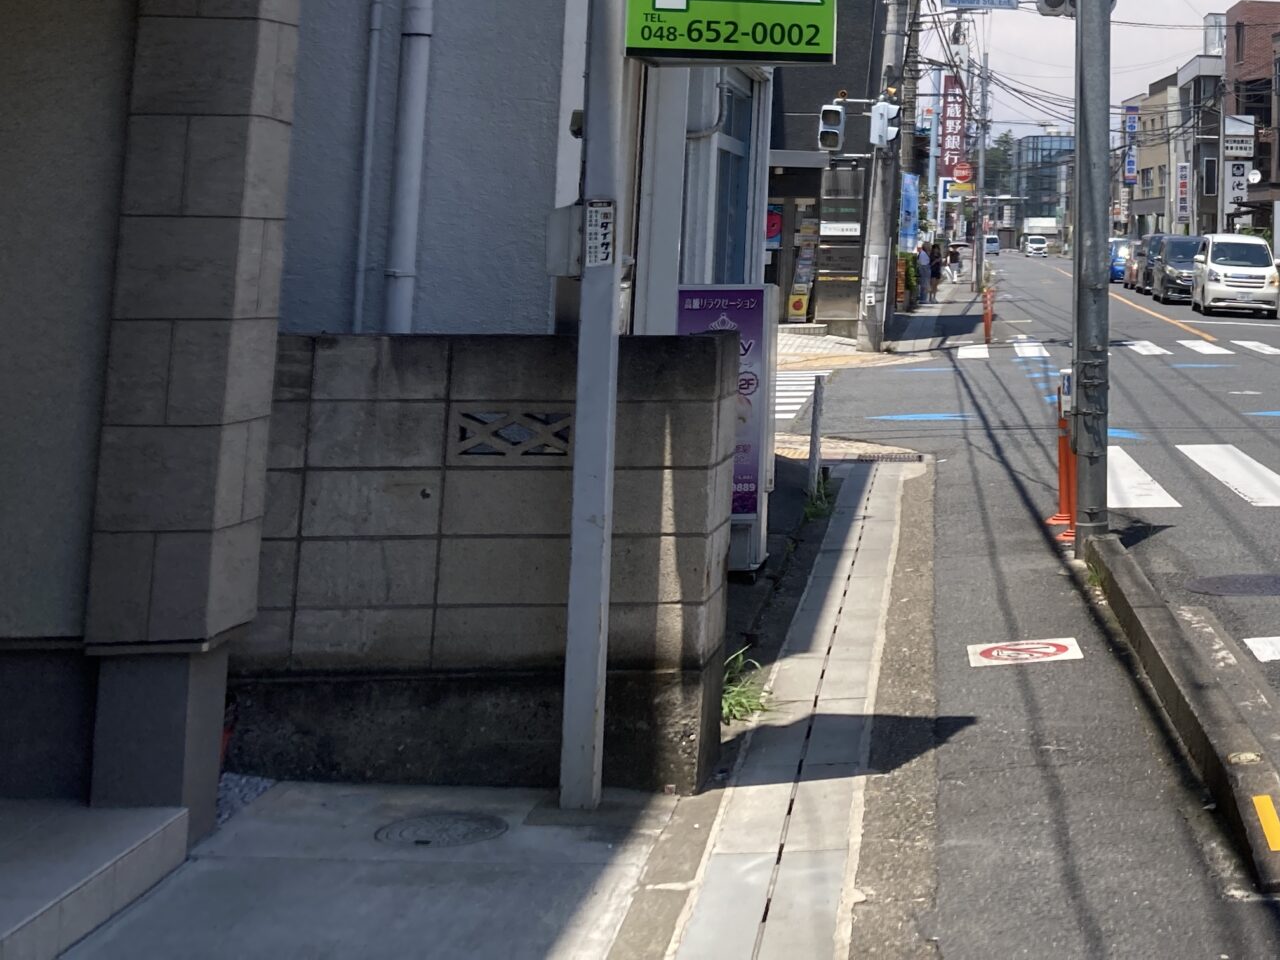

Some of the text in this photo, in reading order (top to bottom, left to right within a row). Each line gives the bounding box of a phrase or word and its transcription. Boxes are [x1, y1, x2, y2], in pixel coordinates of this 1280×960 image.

[643, 12, 666, 23] TEL.
[640, 19, 820, 47] 048-652-0002
[943, 87, 962, 166] 武蔵野銀行
